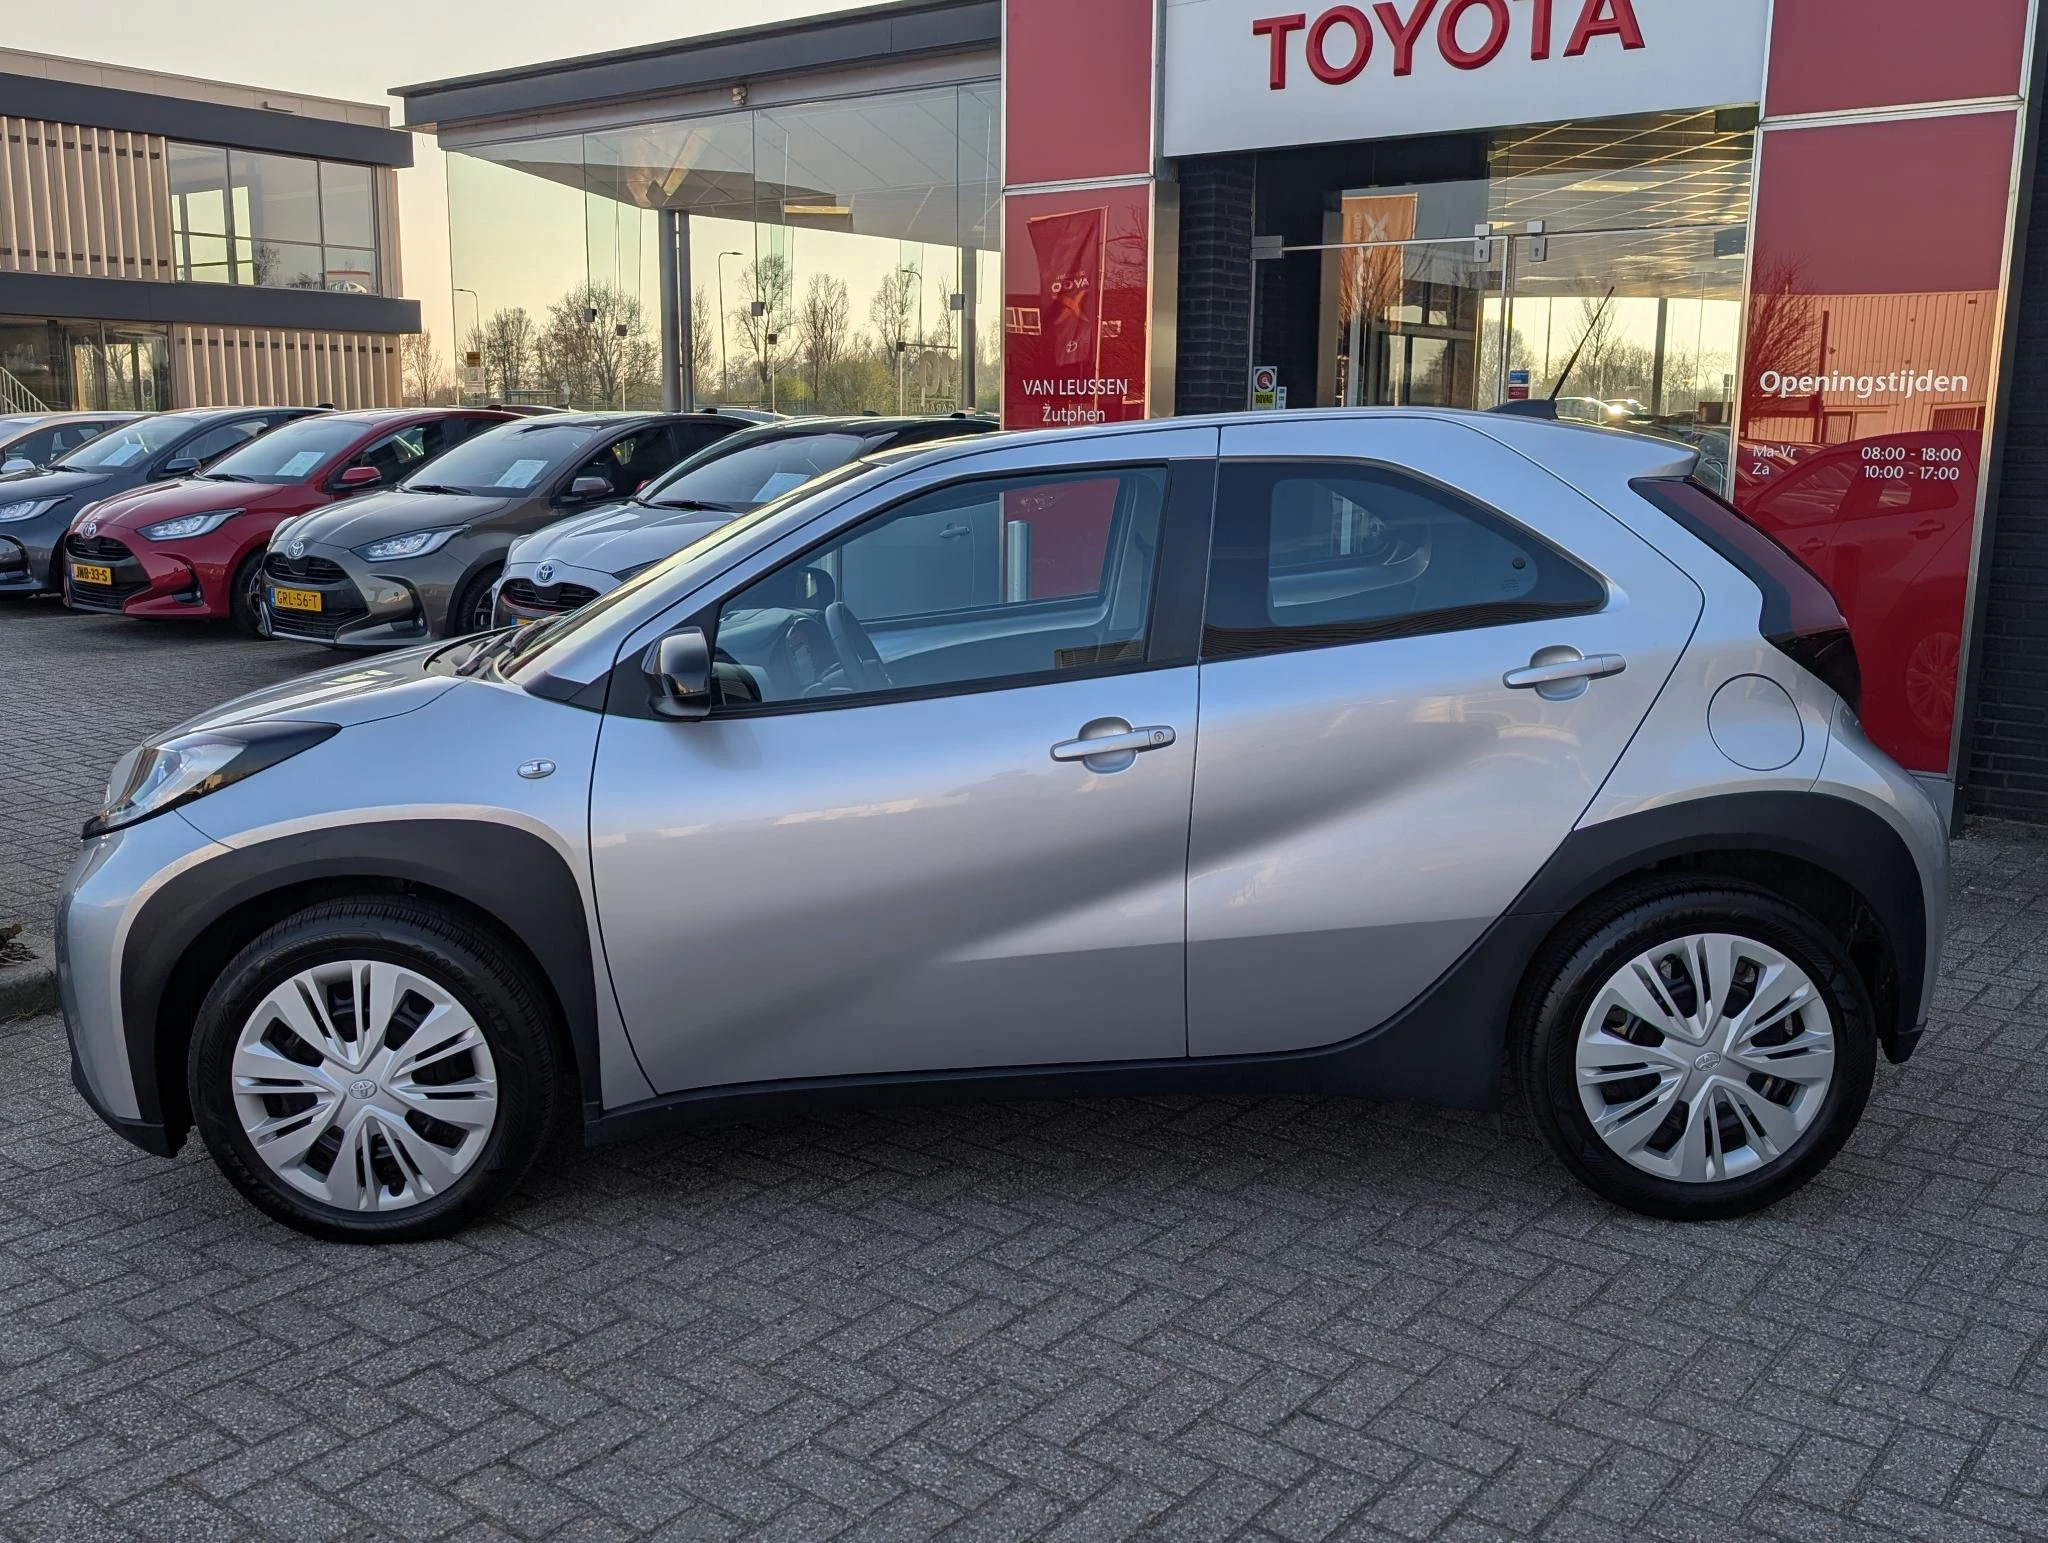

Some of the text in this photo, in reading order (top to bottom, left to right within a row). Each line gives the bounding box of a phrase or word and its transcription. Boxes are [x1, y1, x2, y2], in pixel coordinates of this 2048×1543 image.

[1253, 0, 1646, 91] TOYOTA
[1023, 378, 1128, 396] VAN LEUSSEN
[1759, 370, 1968, 399] Openingstijden
[1042, 405, 1106, 426] Zutphen
[1752, 445, 1797, 458] Ma-Vr
[1861, 447, 1906, 461] 08:00
[1921, 448, 1962, 462] 18:00
[1752, 462, 1770, 475] Za
[1864, 465, 1904, 479] 10:00
[1920, 467, 1960, 480] 17:00
[277, 591, 318, 609] GRL-56-T
